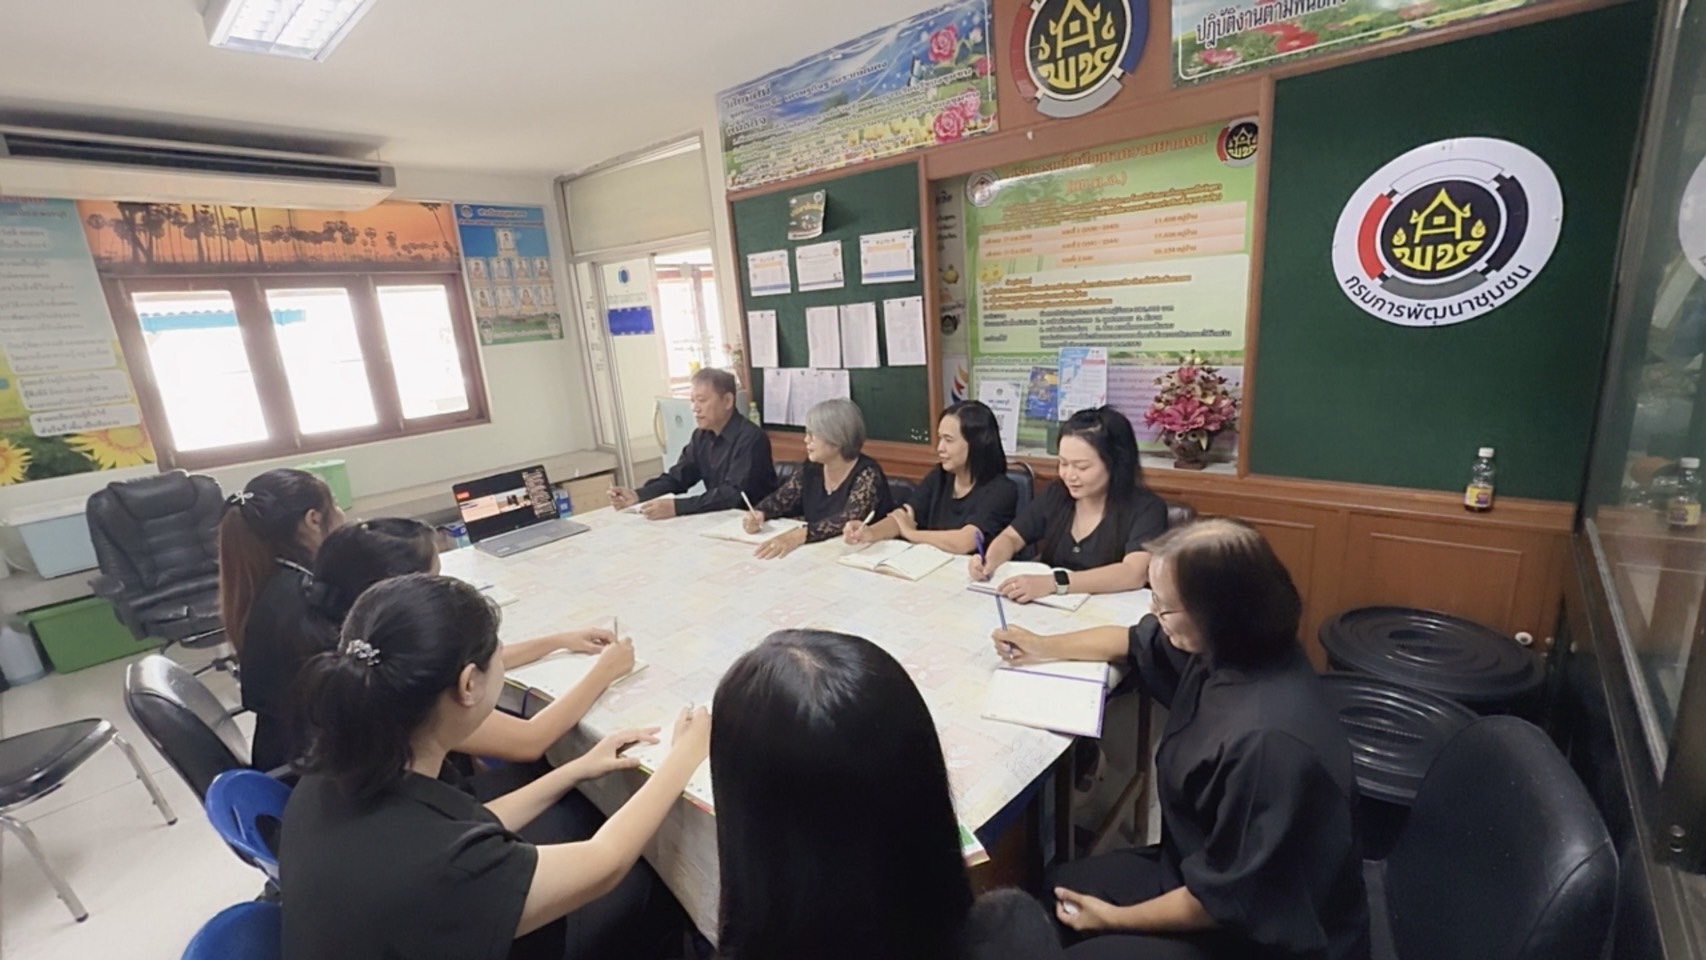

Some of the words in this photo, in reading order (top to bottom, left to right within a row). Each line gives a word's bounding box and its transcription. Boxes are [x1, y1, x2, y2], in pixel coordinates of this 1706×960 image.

[1345, 264, 1533, 322] กรมการพัฒนาชุมชน
